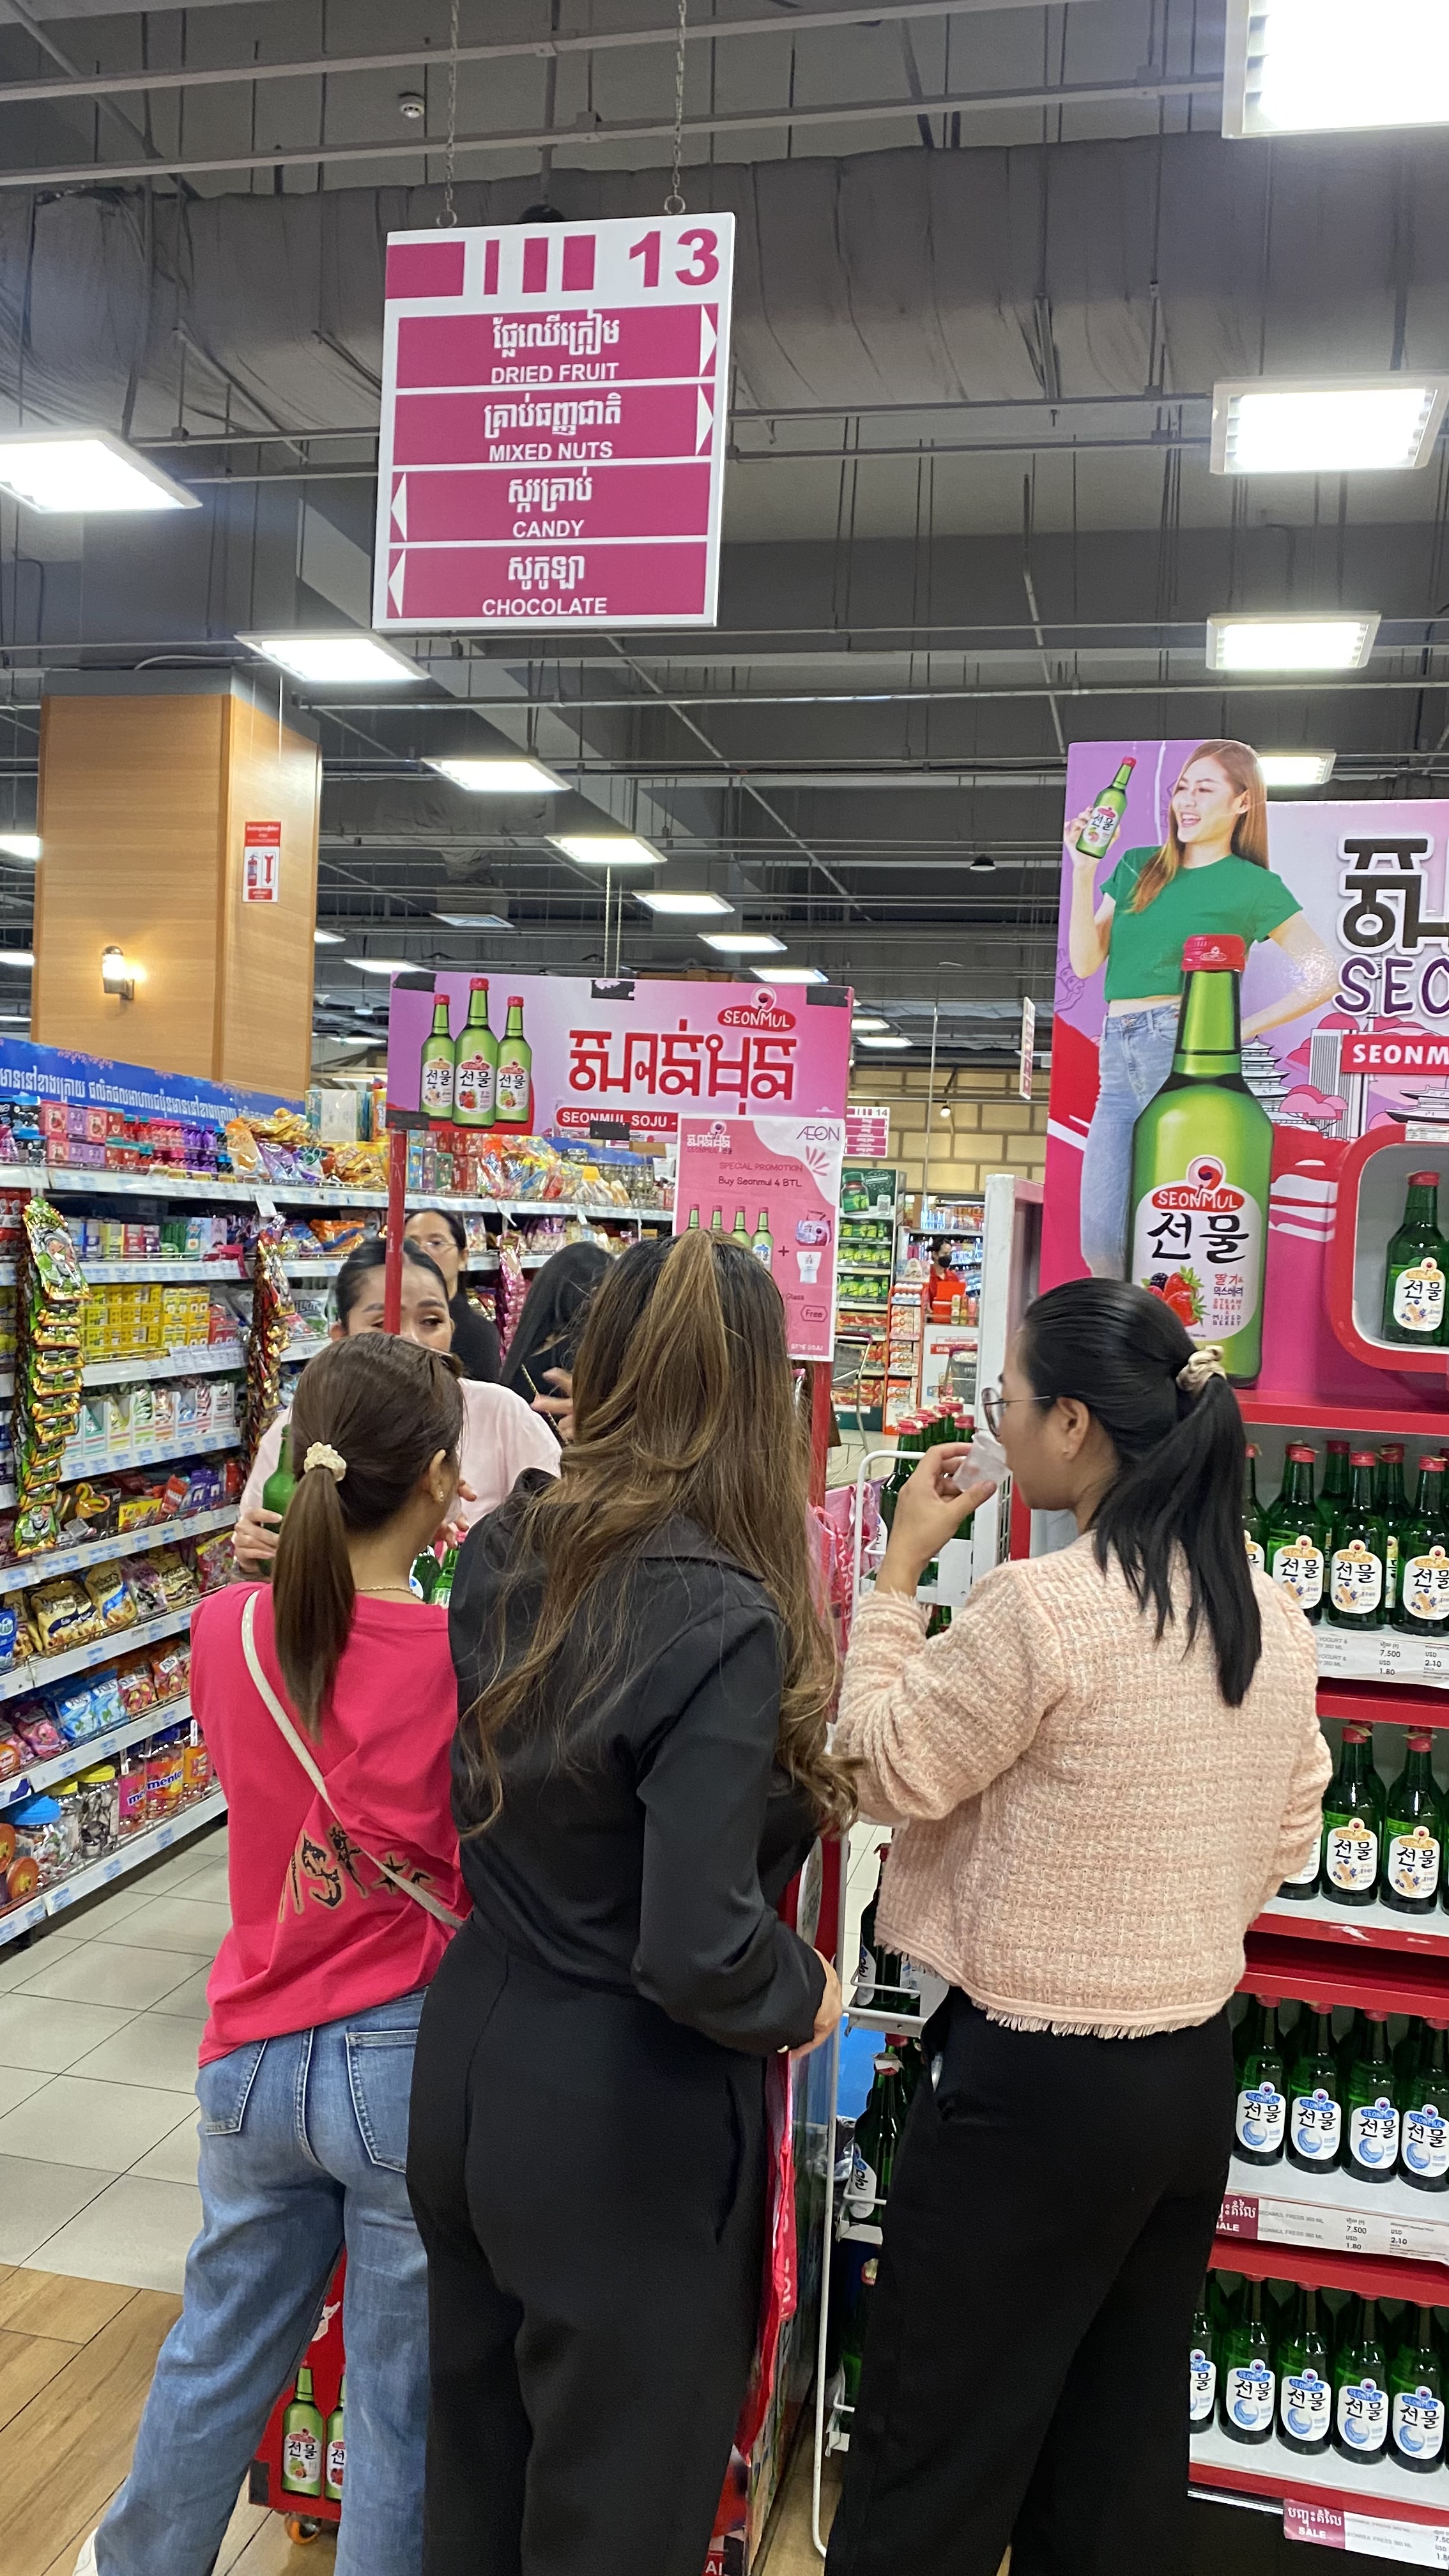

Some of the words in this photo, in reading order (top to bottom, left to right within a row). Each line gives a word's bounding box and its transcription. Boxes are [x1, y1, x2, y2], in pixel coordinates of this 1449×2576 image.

[629, 228, 719, 288] 13
[493, 309, 620, 358] ផ្លែឈើក្រៀម
[491, 365, 553, 384] DRIED
[559, 362, 620, 381] FRUIT
[484, 392, 622, 438] គ្រាប់ធញ្ញជាតិ
[489, 443, 552, 461] MIXED
[558, 441, 613, 459] NUTS
[509, 466, 592, 513] ស្ករគ្រាប់
[512, 519, 585, 538] CANDY
[508, 555, 585, 590] សូកូឡា
[482, 597, 608, 616] CHOCOLATE
[723, 1008, 790, 1028] SEONMUL
[631, 1114, 667, 1127] SOJU
[719, 1162, 752, 1170] SPECIAL
[755, 1163, 803, 1172] PROMOTION
[718, 1176, 734, 1186] Buy
[737, 1177, 772, 1186] Seonmul
[783, 1179, 802, 1187] BTL
[1158, 1190, 1238, 1209] SEONMUL
[147, 1770, 182, 1790] mento
[1195, 2372, 1211, 2391] 물
[1298, 2527, 1326, 2539] SALE
